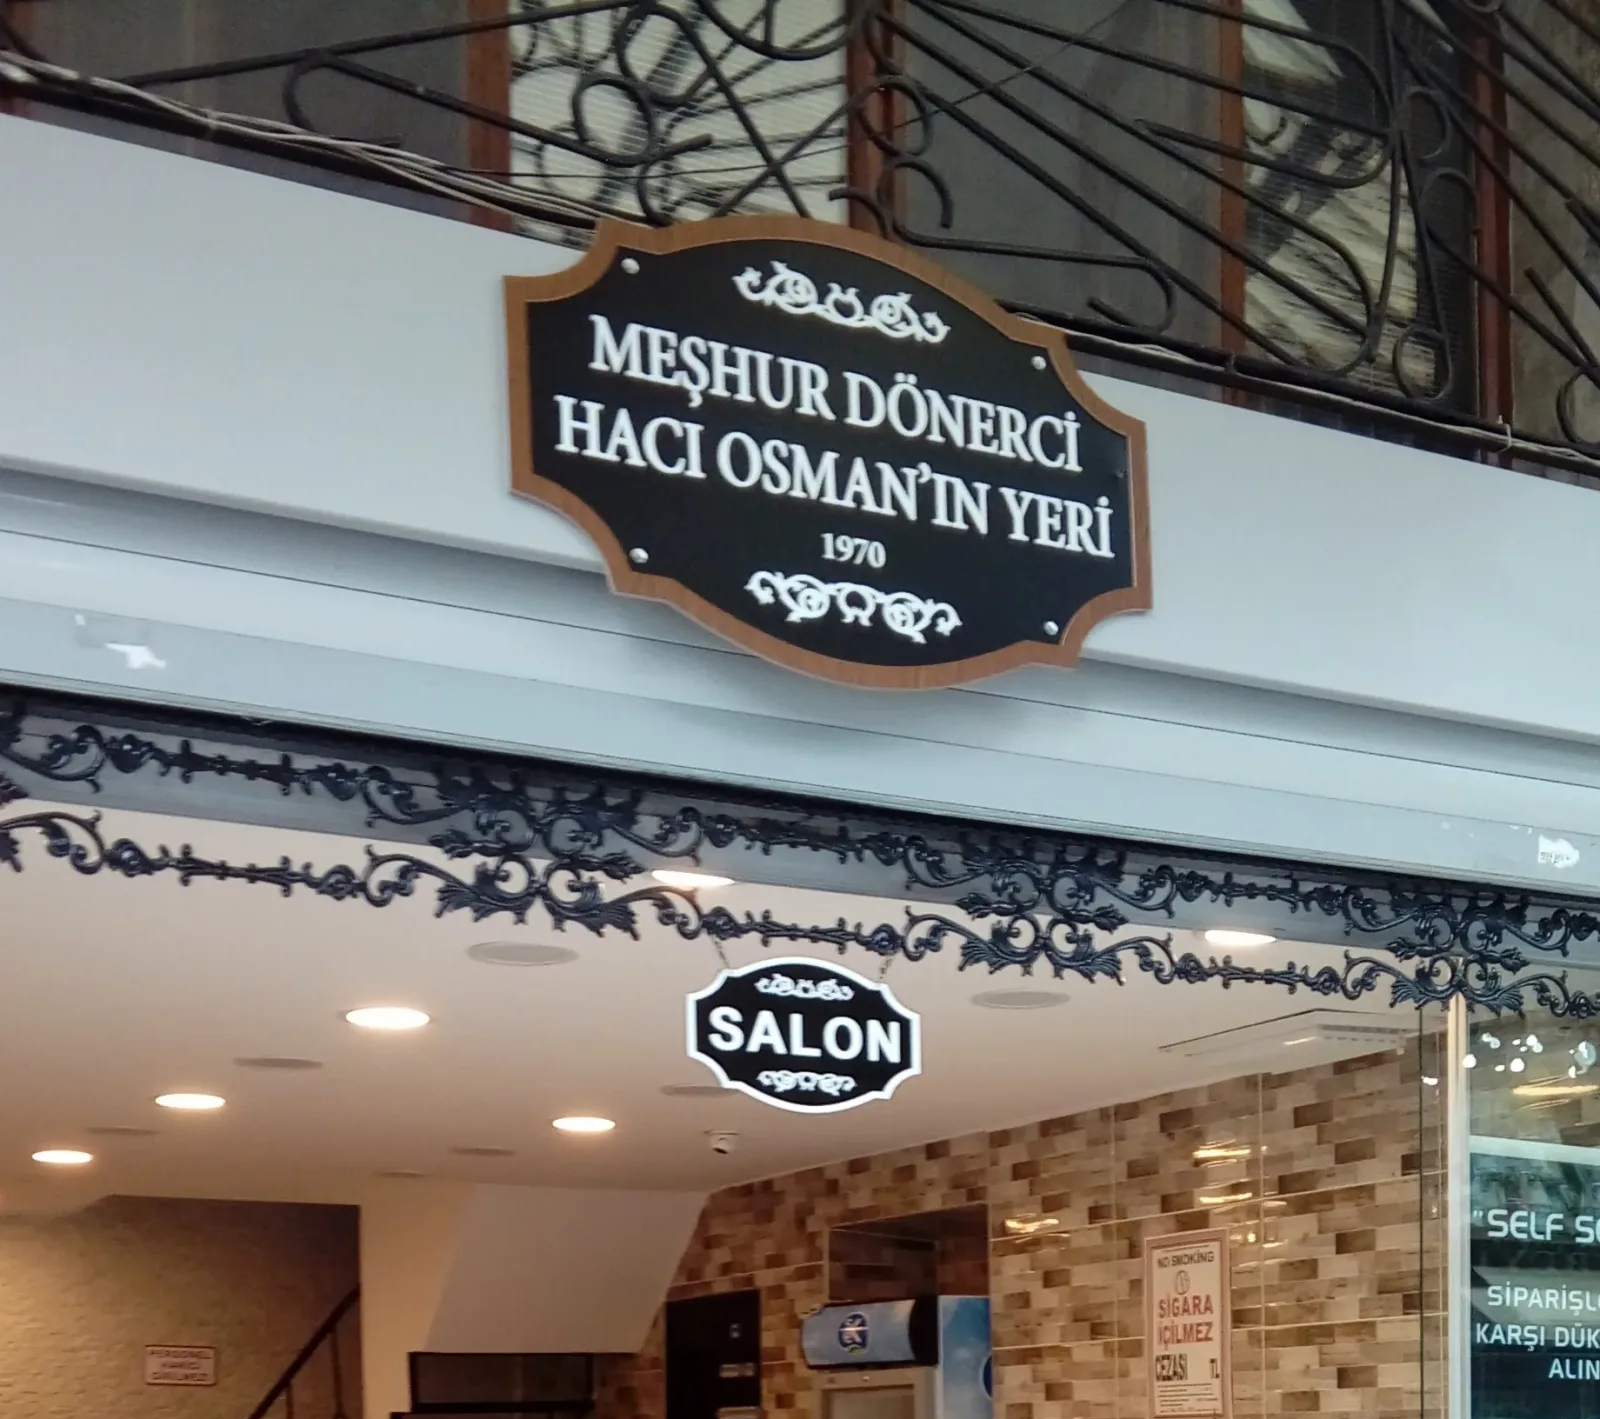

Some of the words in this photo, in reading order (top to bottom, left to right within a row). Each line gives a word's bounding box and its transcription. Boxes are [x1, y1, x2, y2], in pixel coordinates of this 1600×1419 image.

[588, 314, 834, 421] MEŞHUR
[843, 372, 1083, 474] DÖNERCİ
[553, 394, 707, 479] HACI
[998, 486, 1116, 560] YERİ
[820, 532, 887, 569] 1970
[708, 1005, 902, 1064] SALON
[1575, 1215, 1600, 1243] S
[1157, 1293, 1214, 1319] SİGARA
[1487, 1280, 1600, 1317] SİPARİŞL
[1157, 1320, 1214, 1351] İÇİLMEZ
[1476, 1322, 1545, 1351] KARŞI
[1548, 1357, 1600, 1380] ALIN
